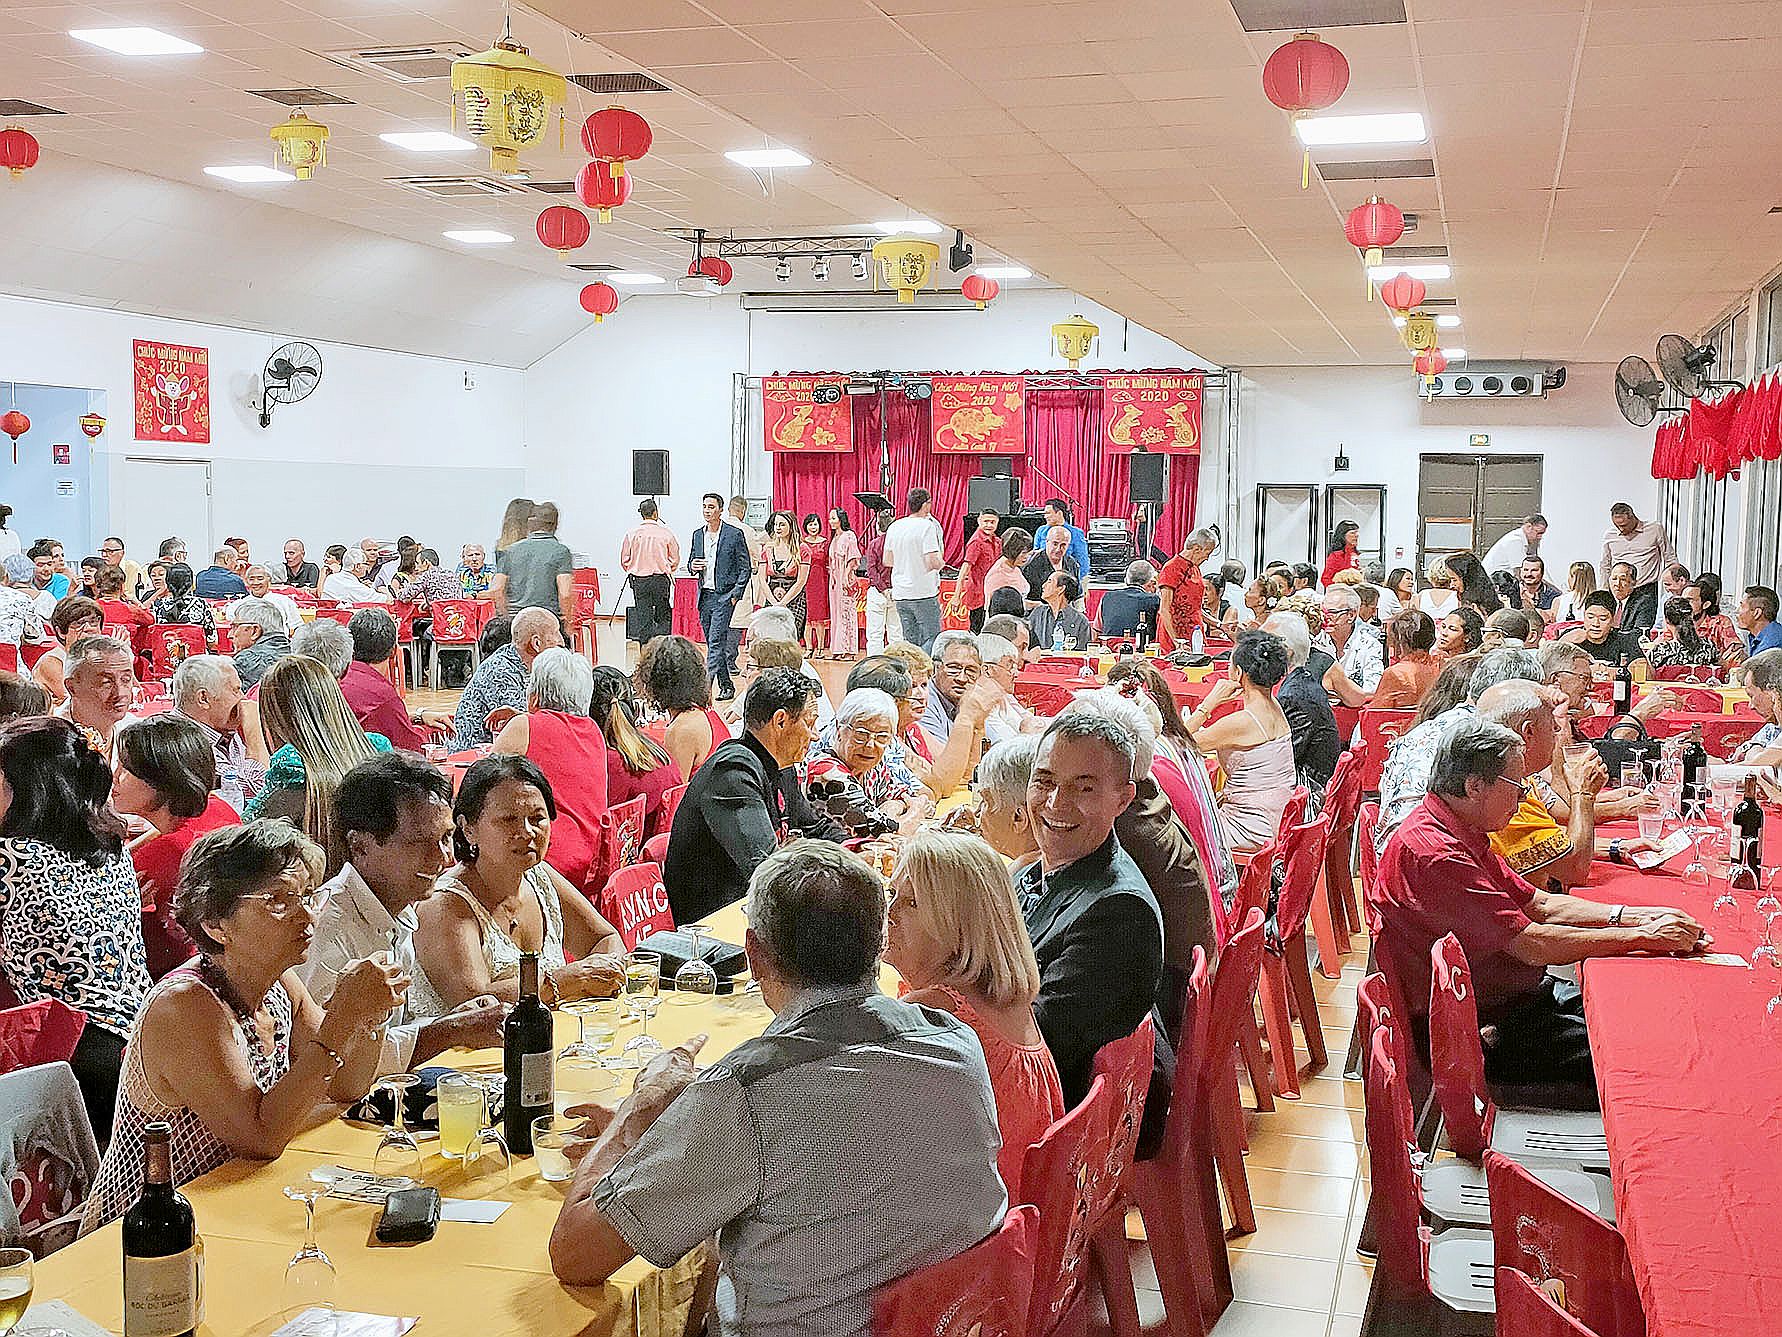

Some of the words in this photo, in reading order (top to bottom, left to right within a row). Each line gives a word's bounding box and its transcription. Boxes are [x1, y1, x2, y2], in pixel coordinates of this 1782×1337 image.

[160, 360, 187, 375] 2020
[1107, 376, 1130, 389] CHÚC
[795, 391, 813, 402] 202
[971, 395, 997, 406] 2020
[1140, 390, 1169, 402] 2020
